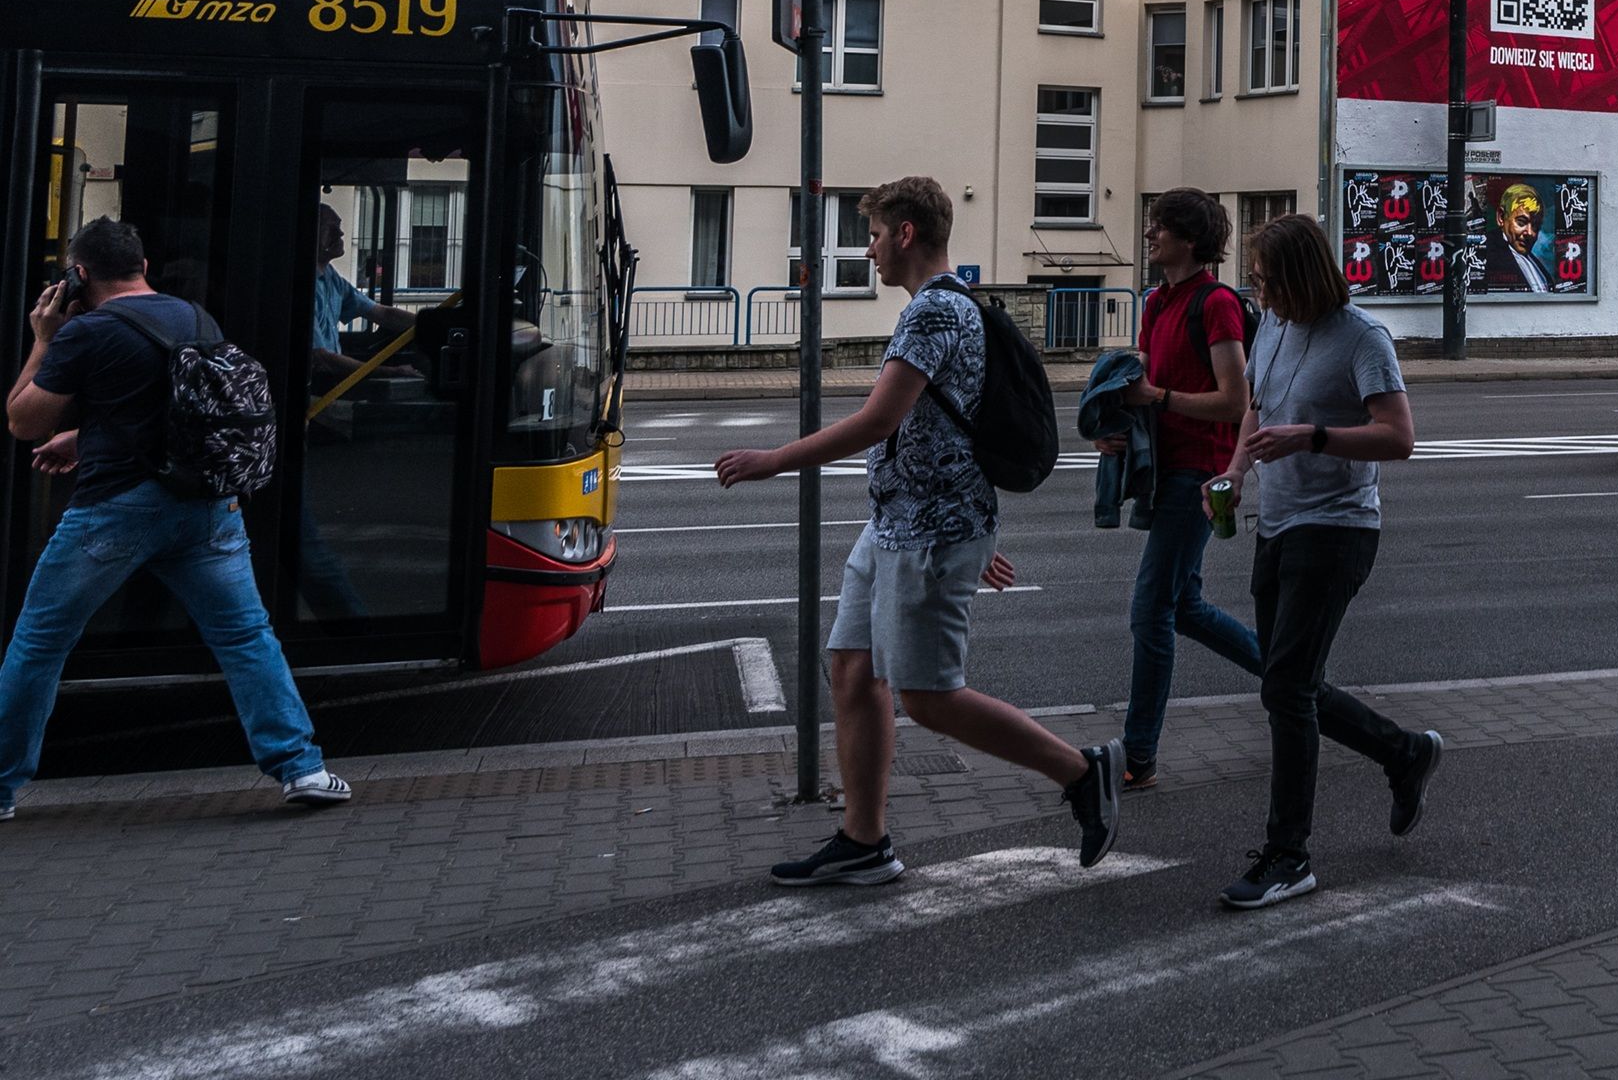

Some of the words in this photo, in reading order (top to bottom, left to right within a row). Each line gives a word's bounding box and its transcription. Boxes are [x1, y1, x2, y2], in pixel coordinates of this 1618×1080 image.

[195, 0, 277, 23] mza
[1490, 46, 1537, 67] DOWIEDZ
[1539, 49, 1556, 71] SIĘ
[1557, 51, 1595, 72] WIĘCEJ
[965, 270, 973, 282] 9
